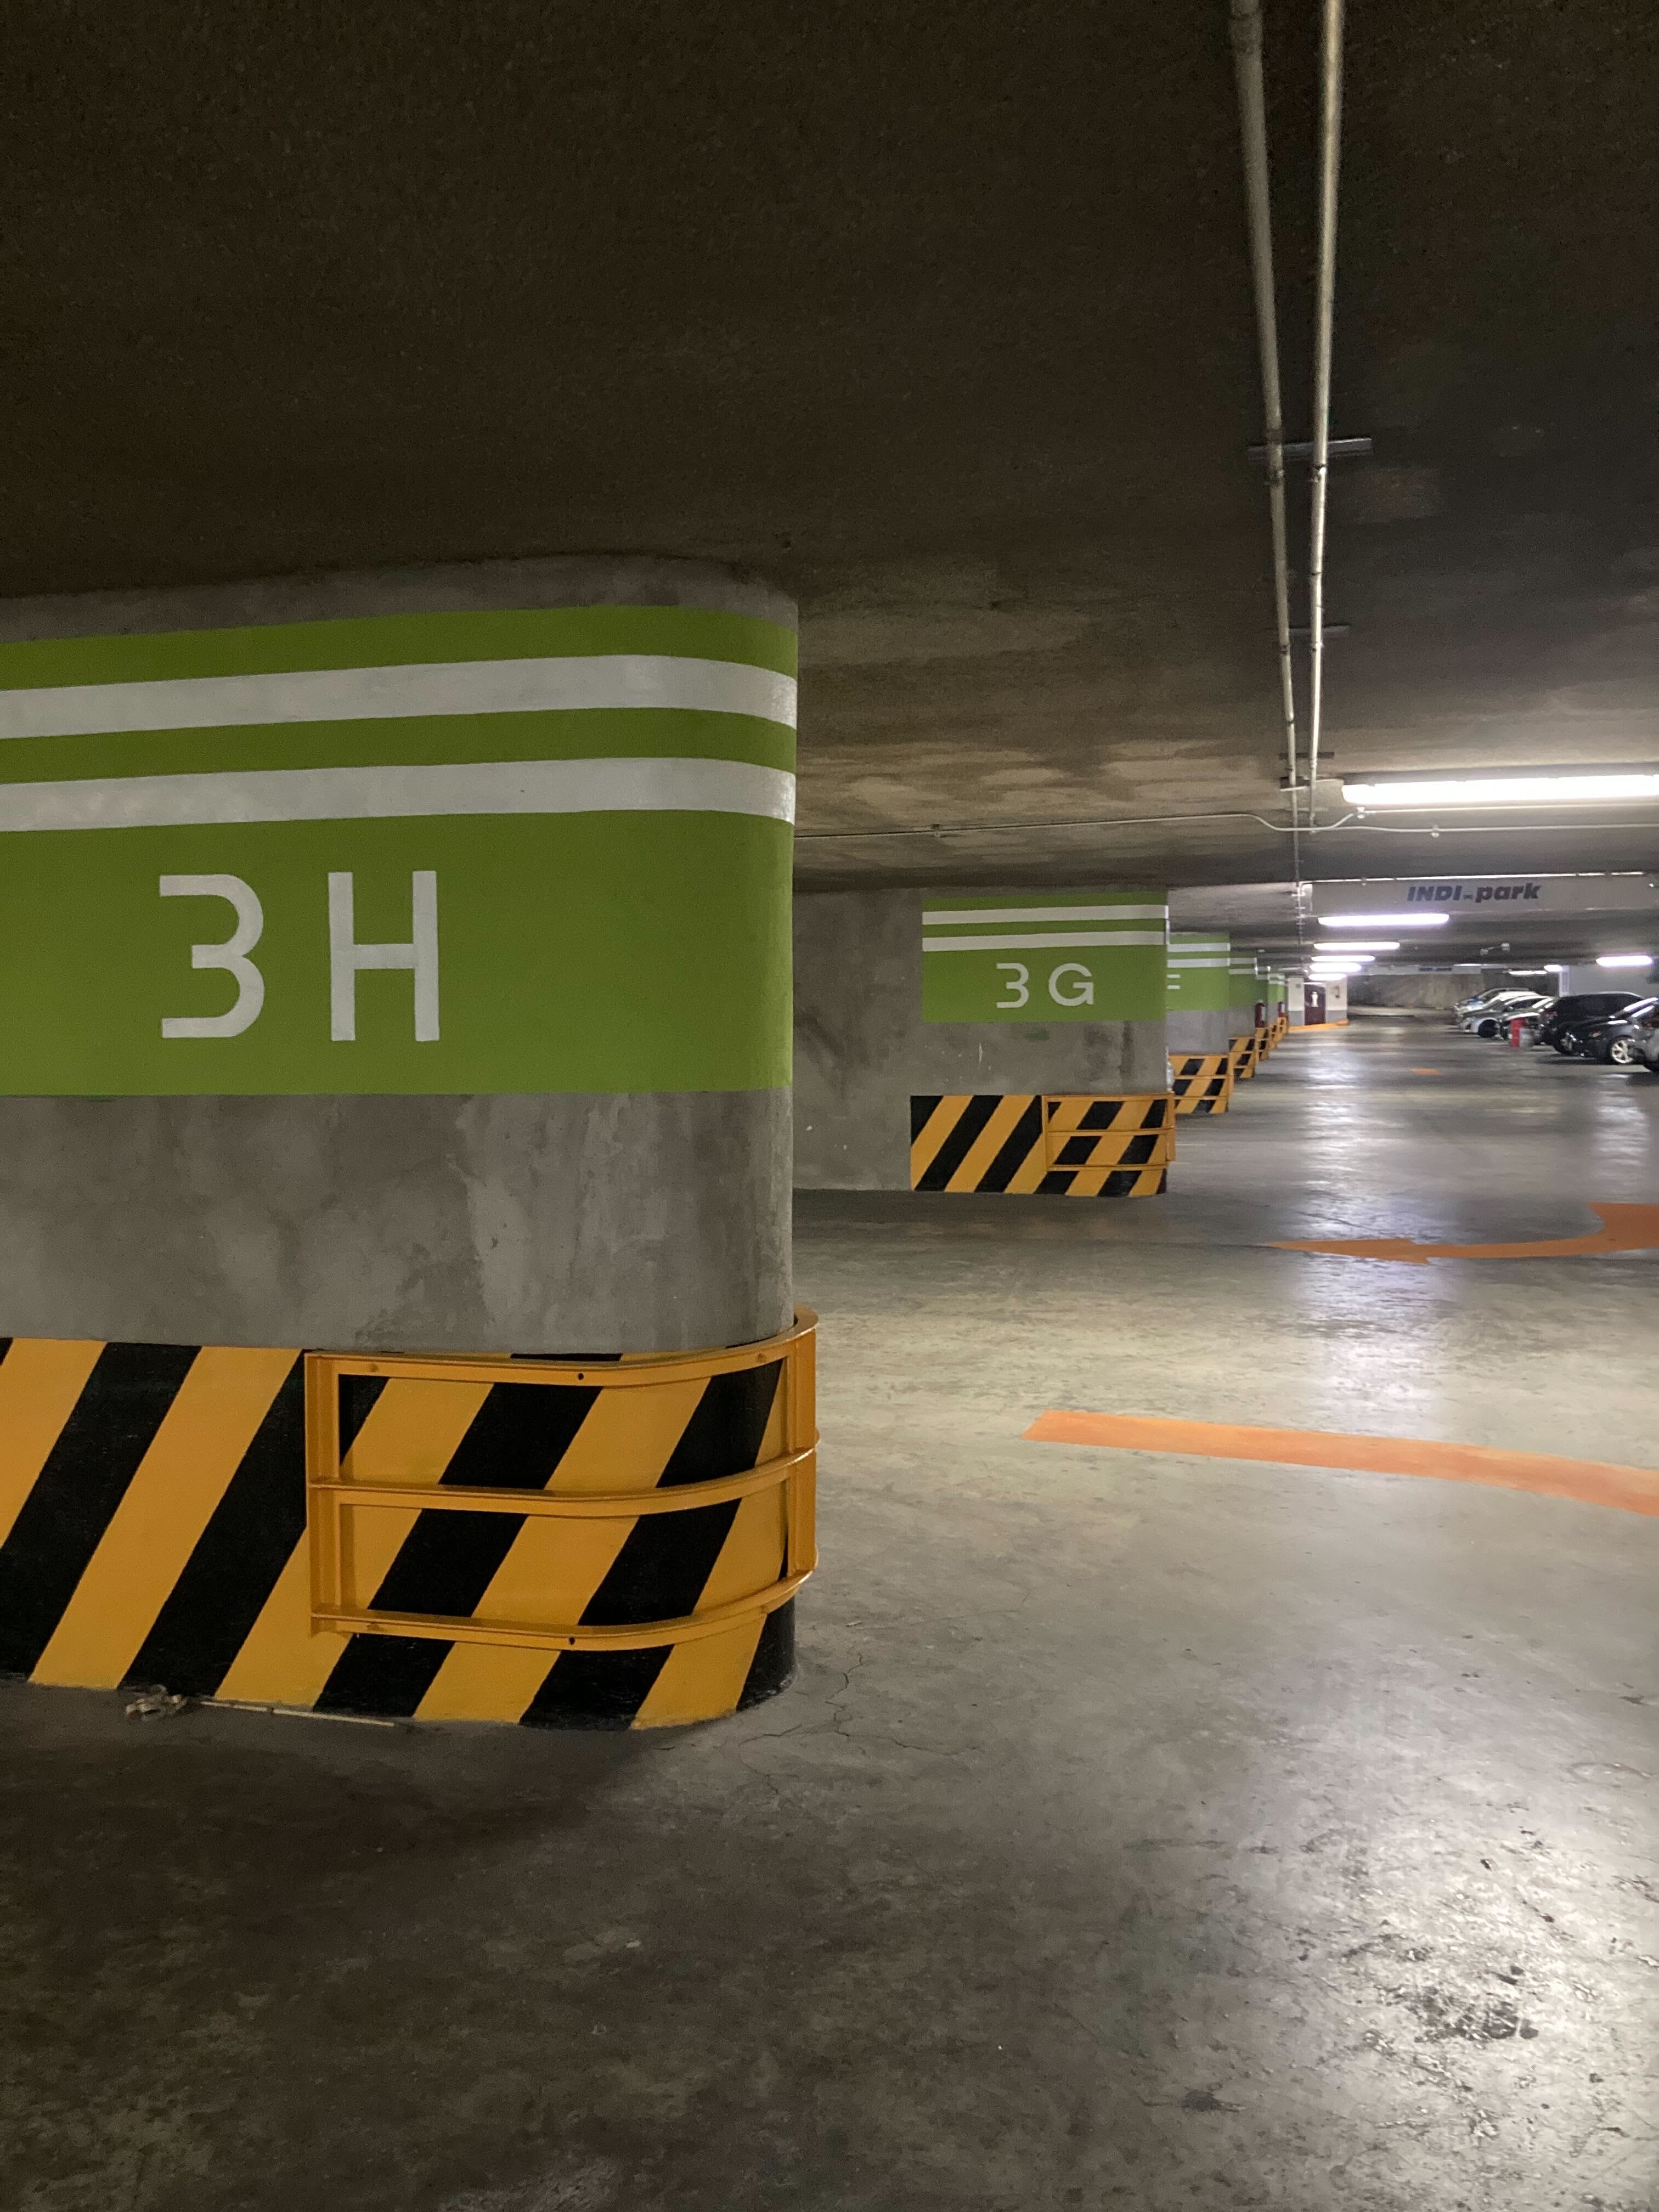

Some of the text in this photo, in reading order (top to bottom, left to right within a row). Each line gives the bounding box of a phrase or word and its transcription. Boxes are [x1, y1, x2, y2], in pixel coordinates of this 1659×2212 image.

[160, 871, 439, 1042] 3 H
[996, 963, 1094, 1008] 3 G
